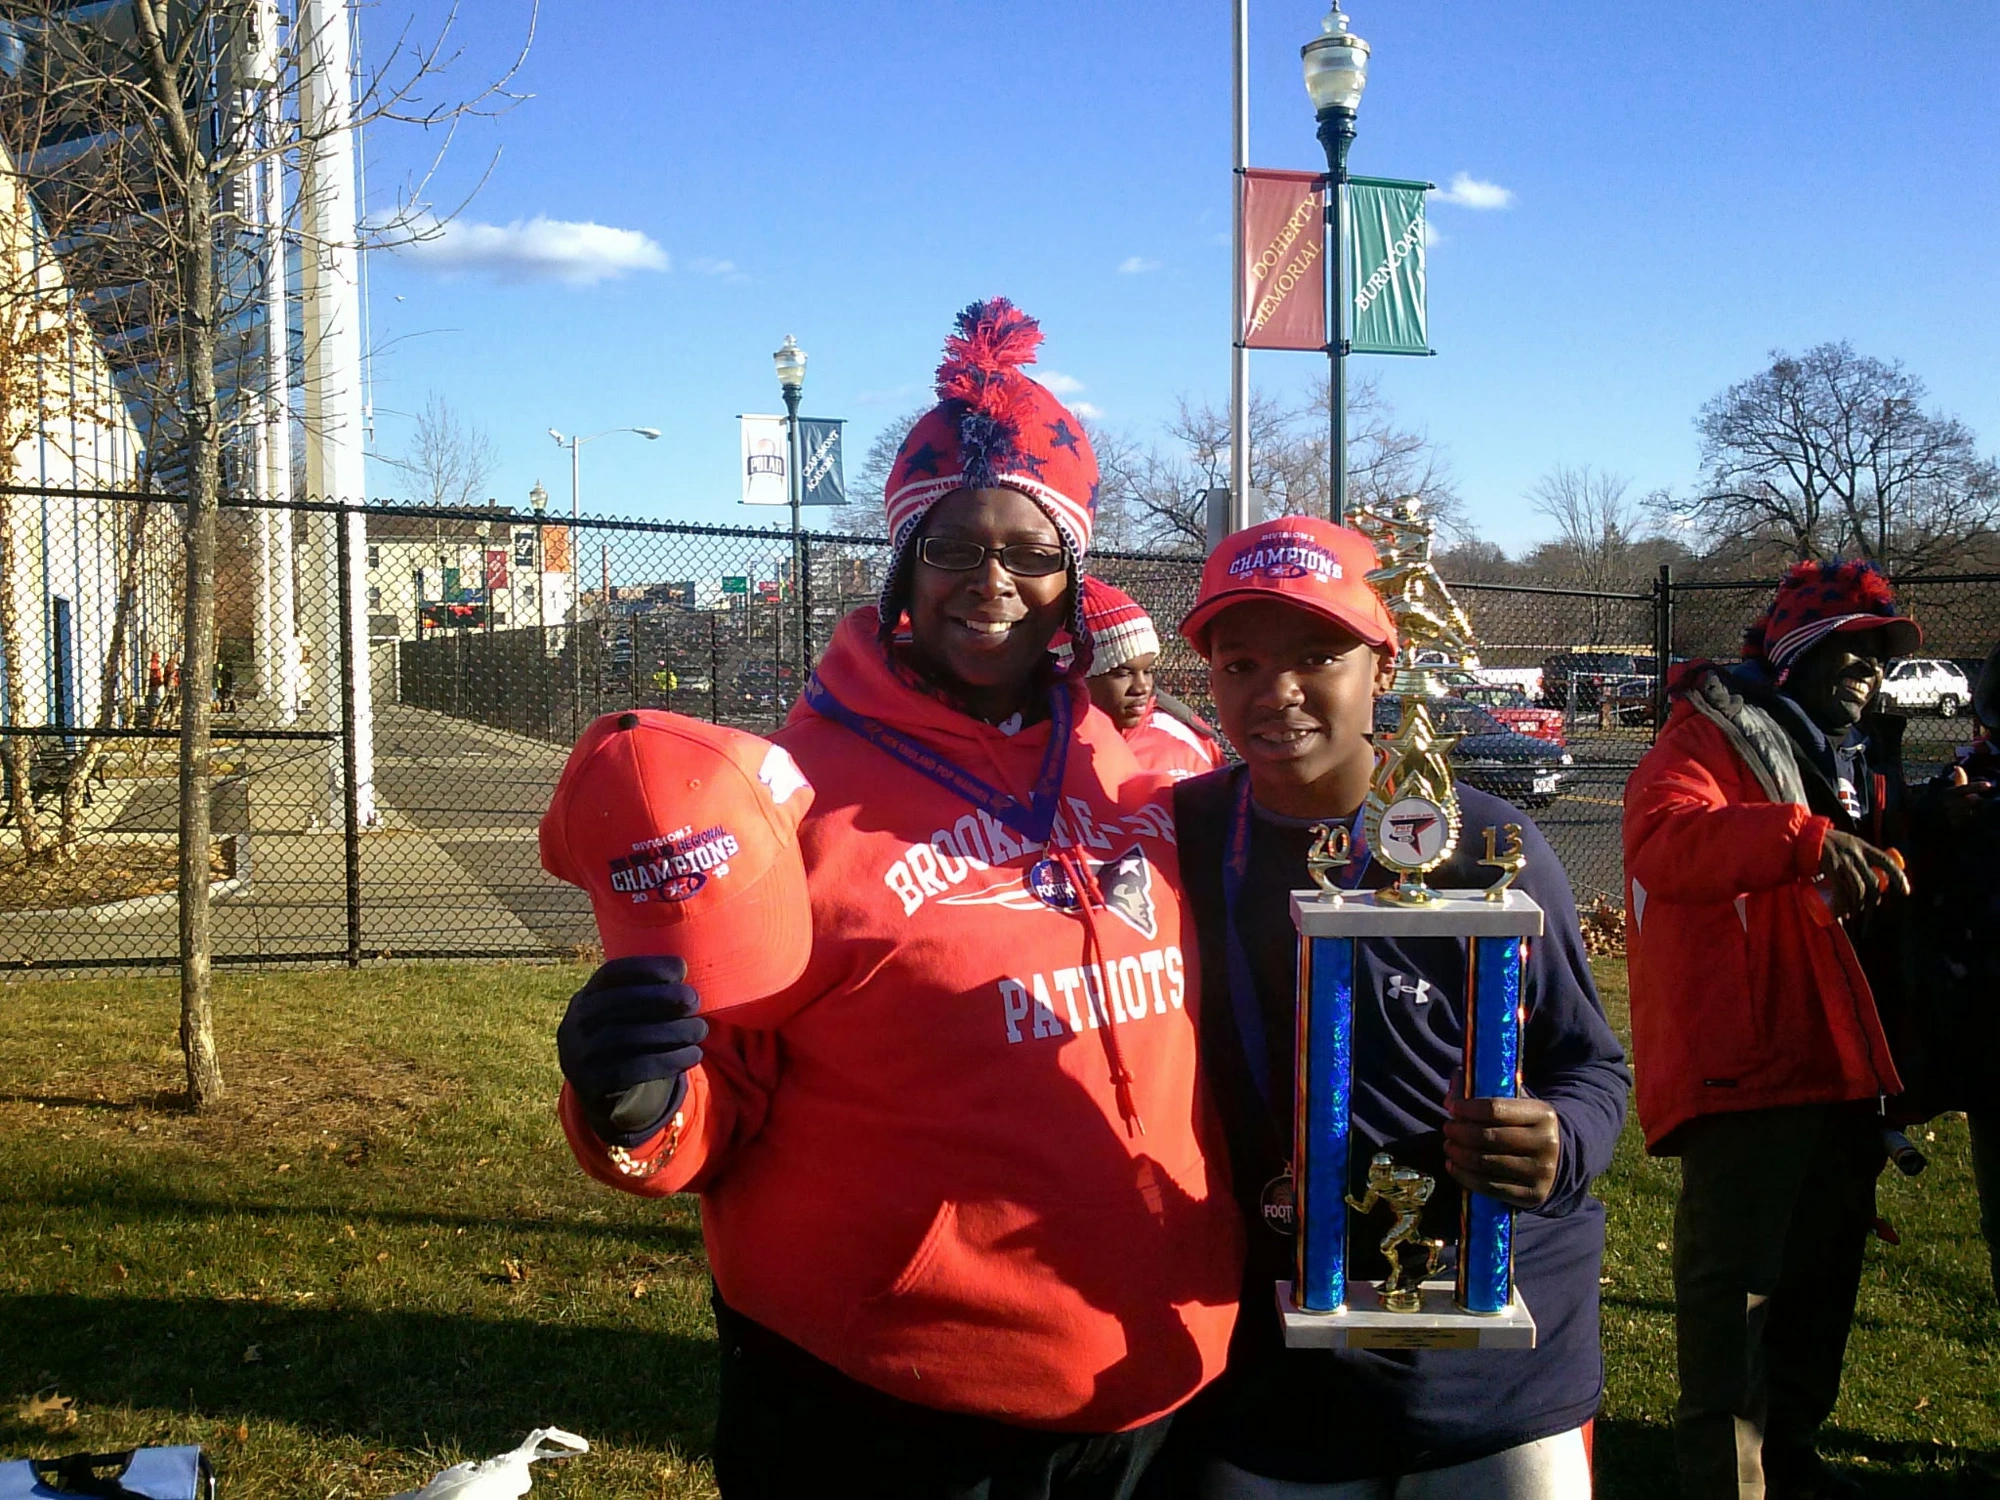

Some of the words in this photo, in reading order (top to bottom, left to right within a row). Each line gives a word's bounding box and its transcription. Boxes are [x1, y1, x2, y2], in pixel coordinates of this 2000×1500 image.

[1252, 192, 1320, 281] DOHERTY
[1354, 206, 1425, 312] BURNCOAT
[1251, 240, 1322, 331] MEMORIAL
[807, 454, 835, 492] ACADEMY
[1229, 546, 1343, 580] CHAMPIONS
[631, 831, 685, 850] DIVISION
[677, 826, 726, 851] REGIONAL
[1308, 823, 1350, 860] 20
[1482, 823, 1523, 862] 13
[611, 835, 739, 892] CHAMPIONS
[631, 893, 648, 903] 20
[998, 946, 1185, 1044] PATRIOTS
[1264, 1204, 1294, 1218] FOOT
